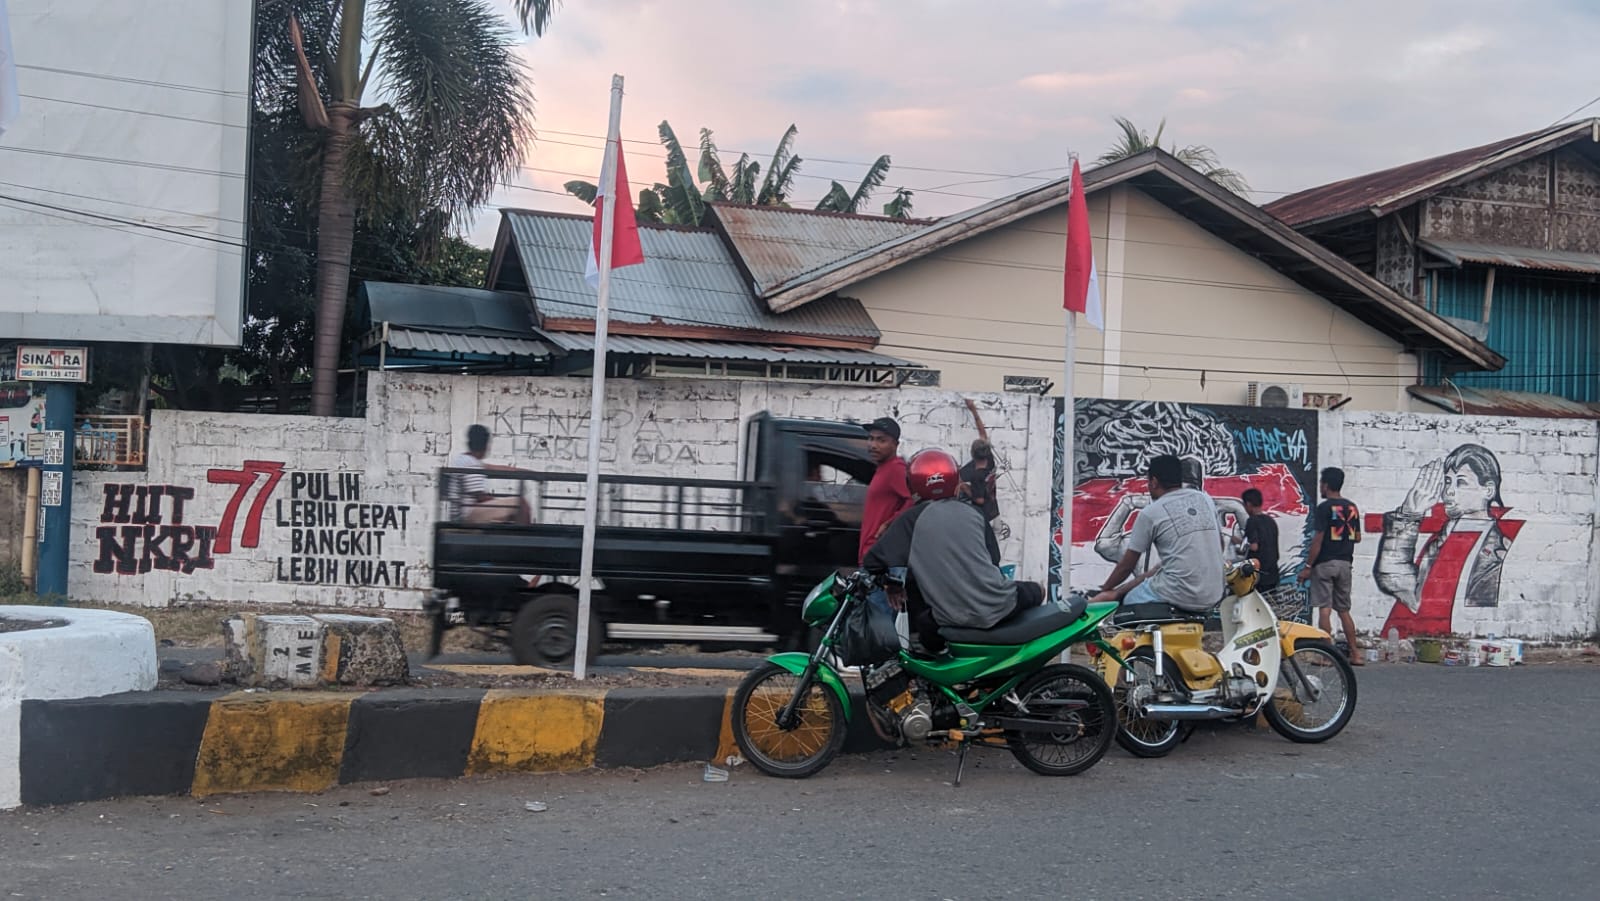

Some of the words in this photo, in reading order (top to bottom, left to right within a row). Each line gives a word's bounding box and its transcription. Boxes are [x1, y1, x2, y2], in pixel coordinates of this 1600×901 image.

[22, 351, 81, 368] SINATRA
[494, 404, 665, 440] KENAPA
[631, 443, 699, 465] ADA
[291, 472, 360, 501] PULIH
[100, 483, 195, 524] HUT
[207, 460, 286, 554] 77
[276, 499, 337, 527] LEBIH
[344, 503, 410, 530] CEPAT
[93, 524, 217, 575] NKRI
[291, 528, 385, 556] BANGKIT
[276, 557, 338, 583] LEBIH
[345, 561, 405, 586] KUAT
[273, 647, 290, 657] 2
